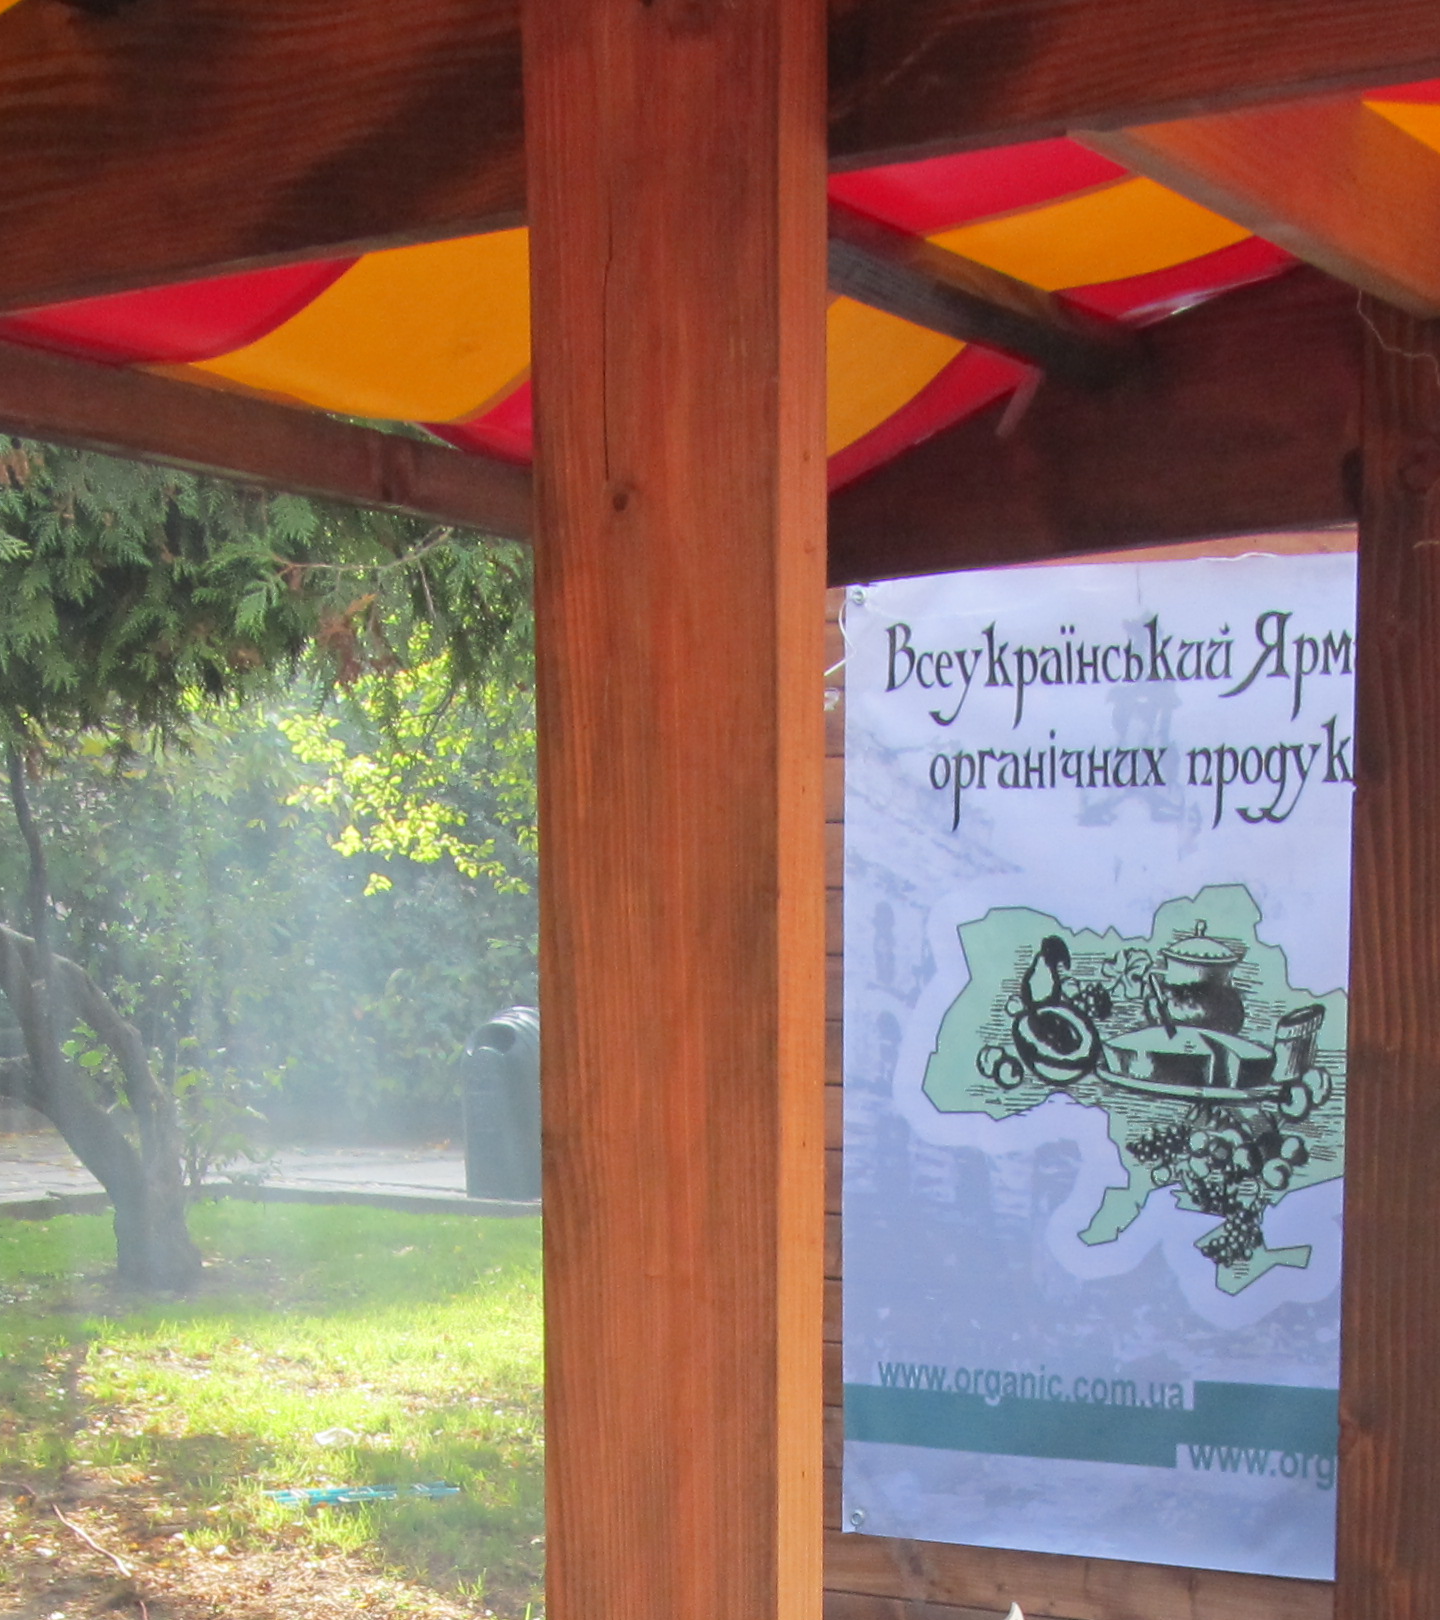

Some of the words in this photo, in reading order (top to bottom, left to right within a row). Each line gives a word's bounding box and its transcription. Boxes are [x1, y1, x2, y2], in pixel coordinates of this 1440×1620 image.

[885, 614, 1235, 728] Всеукраїнський
[929, 729, 1168, 831] органічних
[877, 1360, 1185, 1412] www.organic.com.ua
